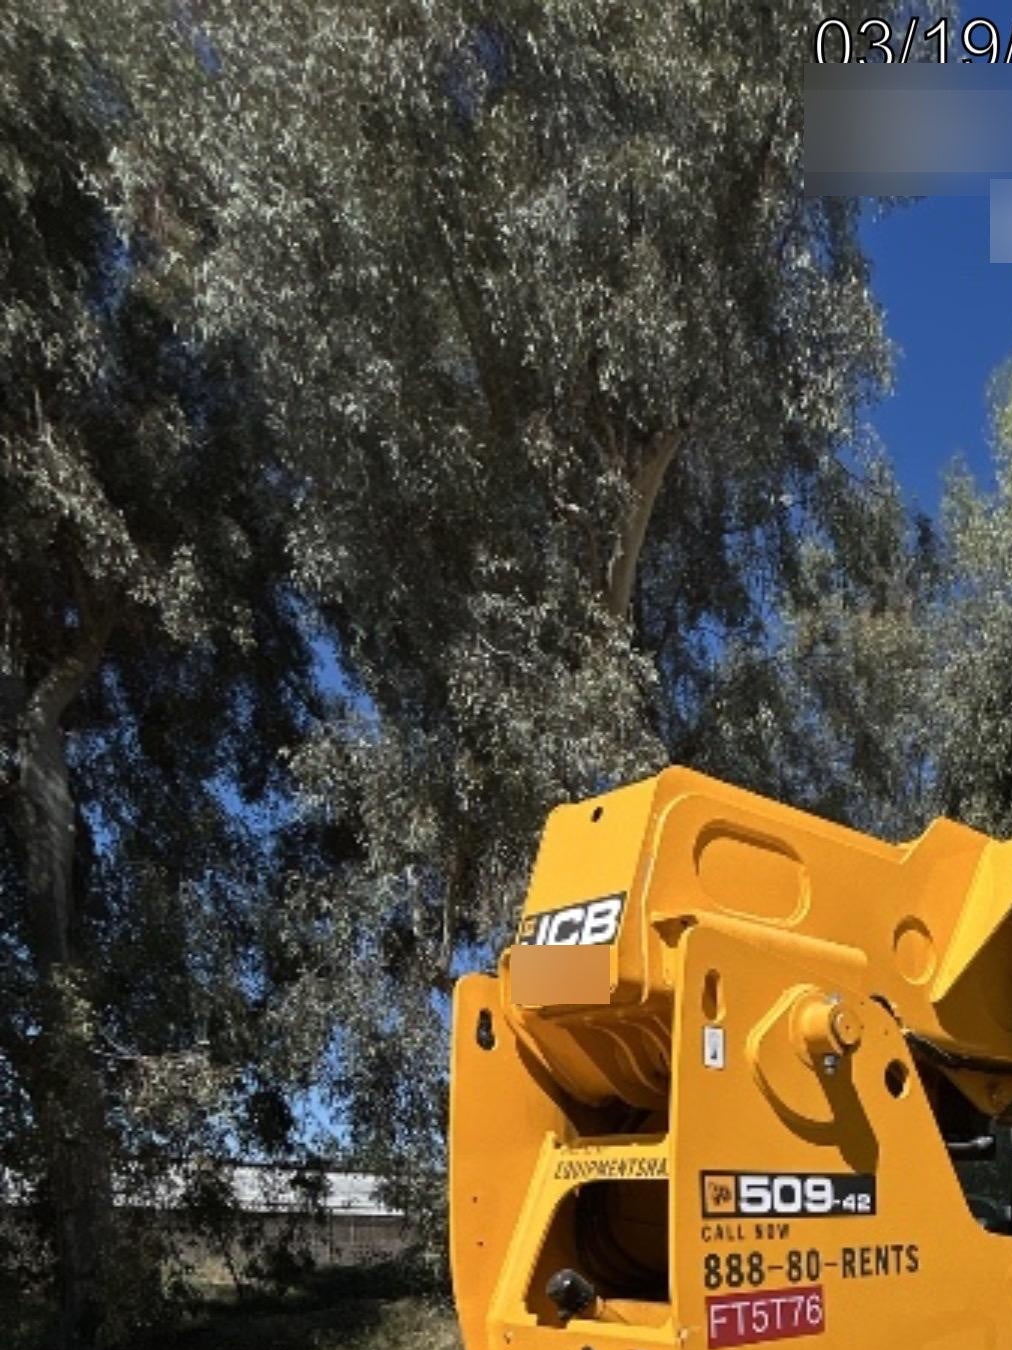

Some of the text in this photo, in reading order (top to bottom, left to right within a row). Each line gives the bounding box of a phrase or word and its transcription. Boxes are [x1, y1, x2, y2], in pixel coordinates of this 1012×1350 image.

[520, 899, 622, 945] JCB
[738, 1175, 872, 1214] 509-42
[701, 1223, 790, 1242] CALL NOW
[704, 1244, 920, 1290] 888-80-RENTS
[709, 1294, 823, 1339] FT5T76
